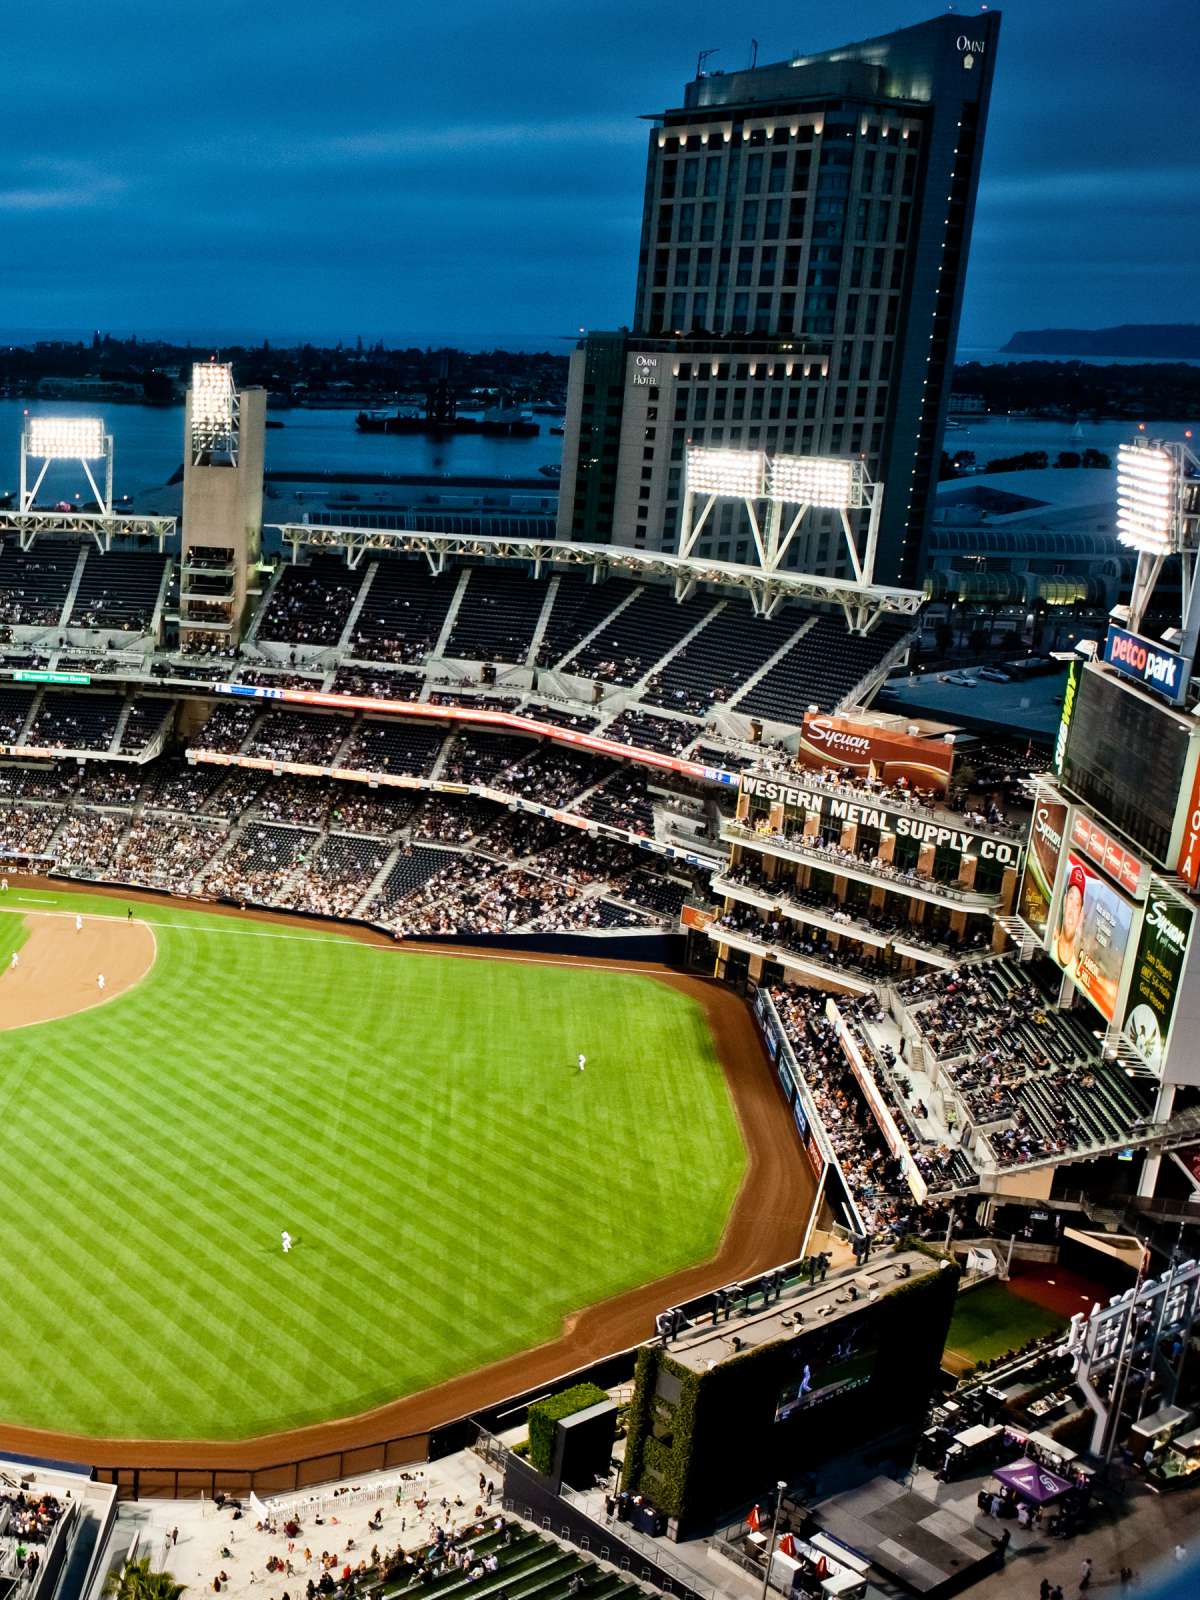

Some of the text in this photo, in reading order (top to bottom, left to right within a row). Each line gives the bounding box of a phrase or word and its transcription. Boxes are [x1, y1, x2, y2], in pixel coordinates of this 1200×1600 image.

[1111, 635, 1177, 687] petco park
[807, 719, 871, 750] Sycuan
[1055, 661, 1076, 775] SUBWAY
[741, 776, 1017, 866] WESTERN METAL SUPPLY CO.
[1145, 900, 1187, 952] Sycuan
